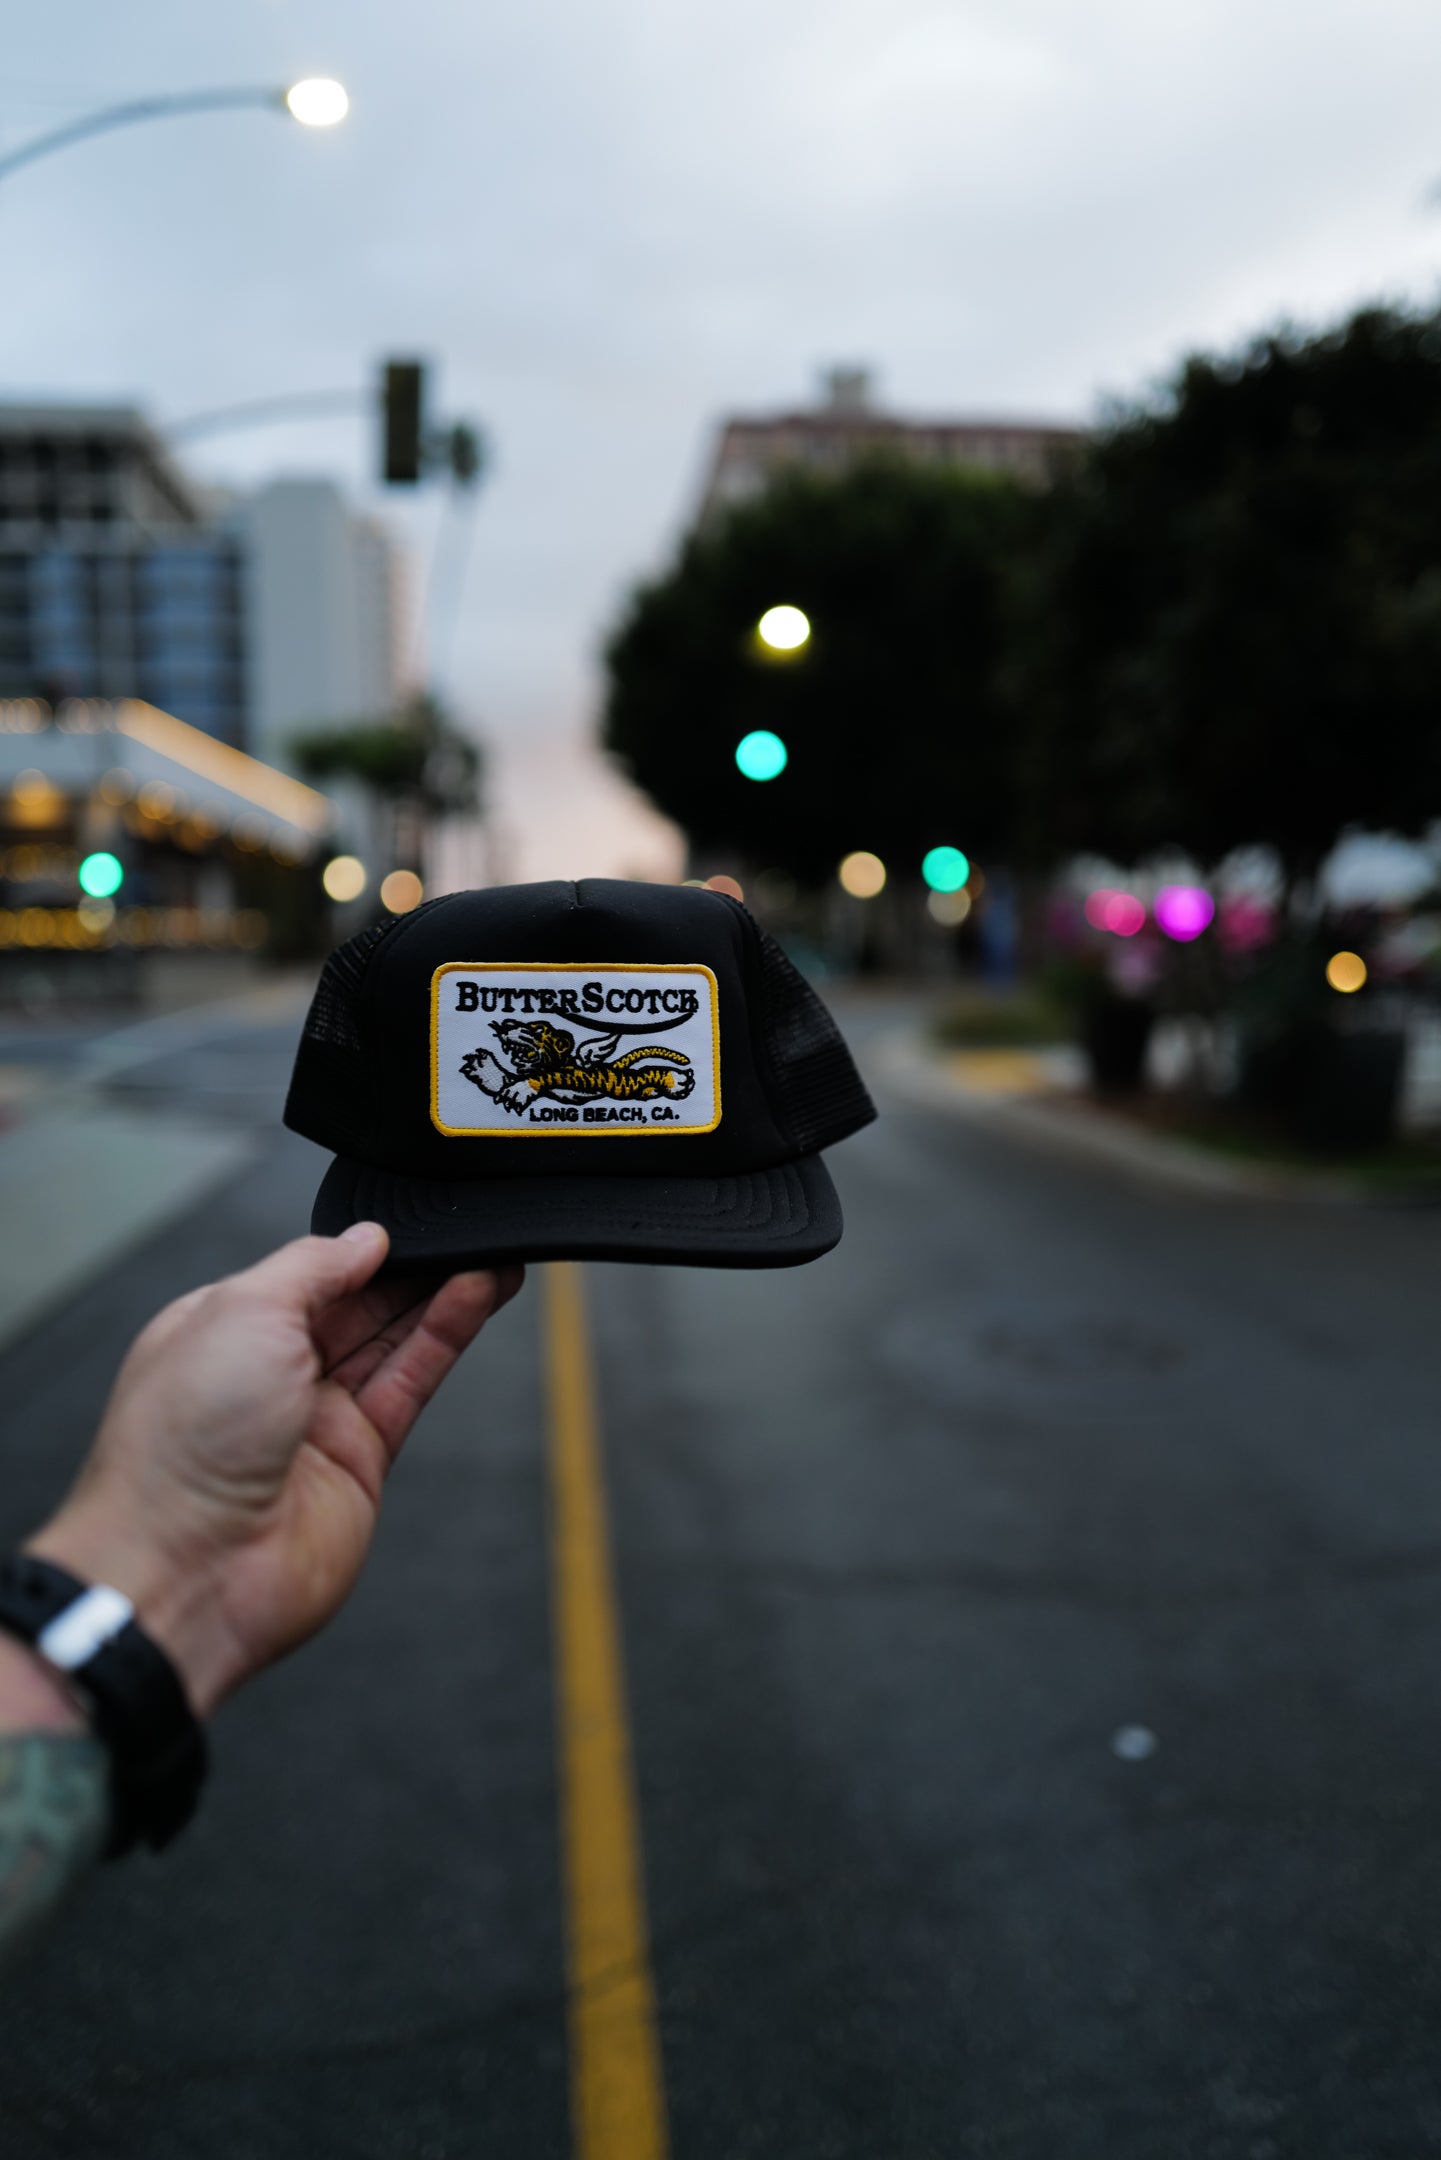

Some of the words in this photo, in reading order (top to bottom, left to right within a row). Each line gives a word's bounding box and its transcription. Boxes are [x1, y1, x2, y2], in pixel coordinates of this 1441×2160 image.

[529, 1107, 579, 1122] LONG
[584, 1107, 648, 1124] BEACH,
[651, 1106, 680, 1121] CA.
